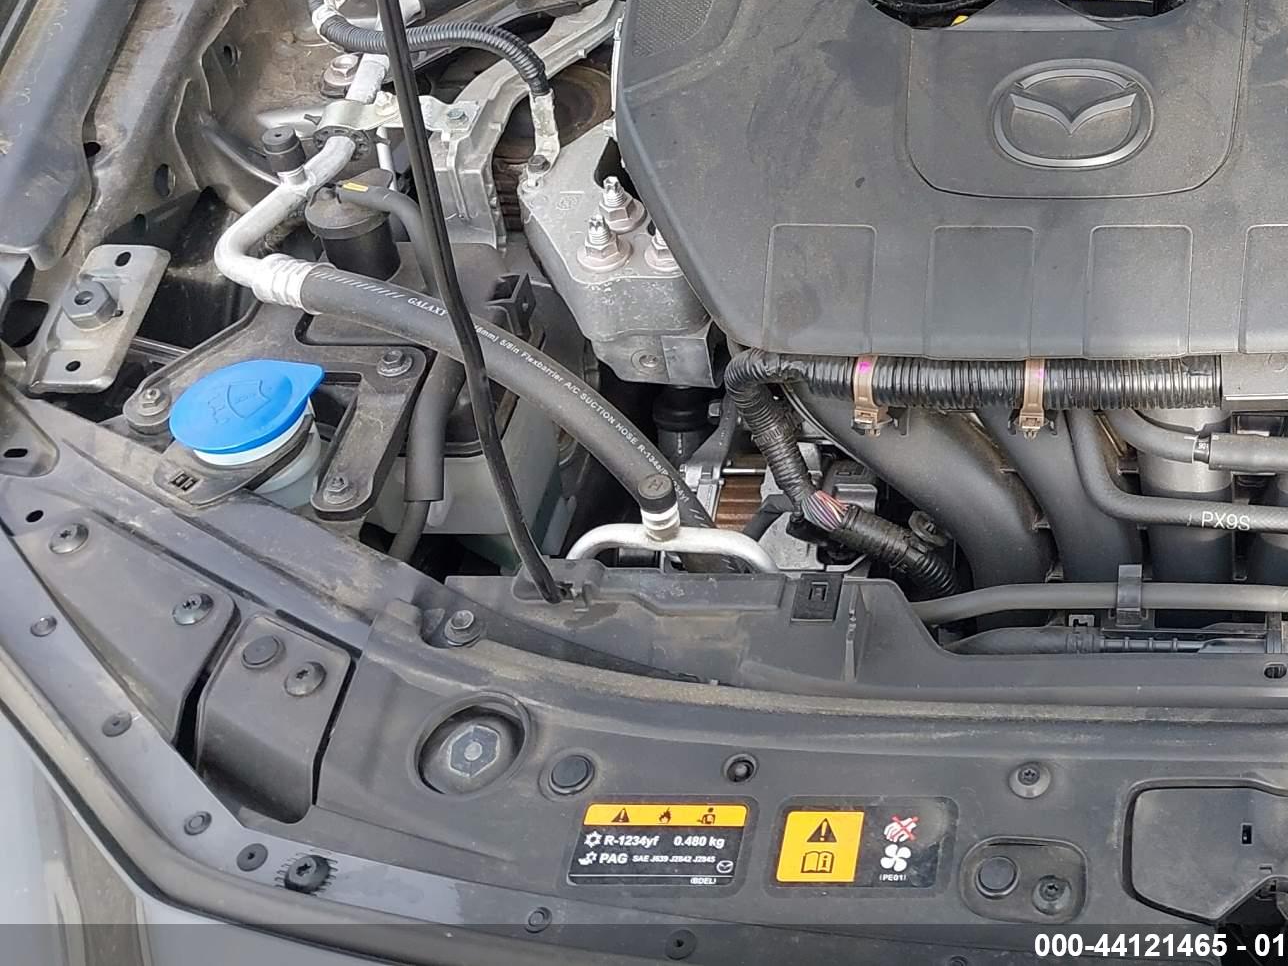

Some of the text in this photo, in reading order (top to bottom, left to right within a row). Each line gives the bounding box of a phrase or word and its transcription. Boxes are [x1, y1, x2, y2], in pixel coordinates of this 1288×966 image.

[407, 297, 448, 317] GALAXY
[520, 351, 565, 383] Flexbarrier
[565, 381, 580, 394] A/C
[579, 392, 616, 425] SUCTION
[615, 422, 640, 446] HOSE
[1201, 510, 1251, 531] PX9S
[604, 835, 725, 850] R-1234yf 0.480 kg
[599, 853, 628, 864] PAG
[632, 855, 650, 863] SAE
